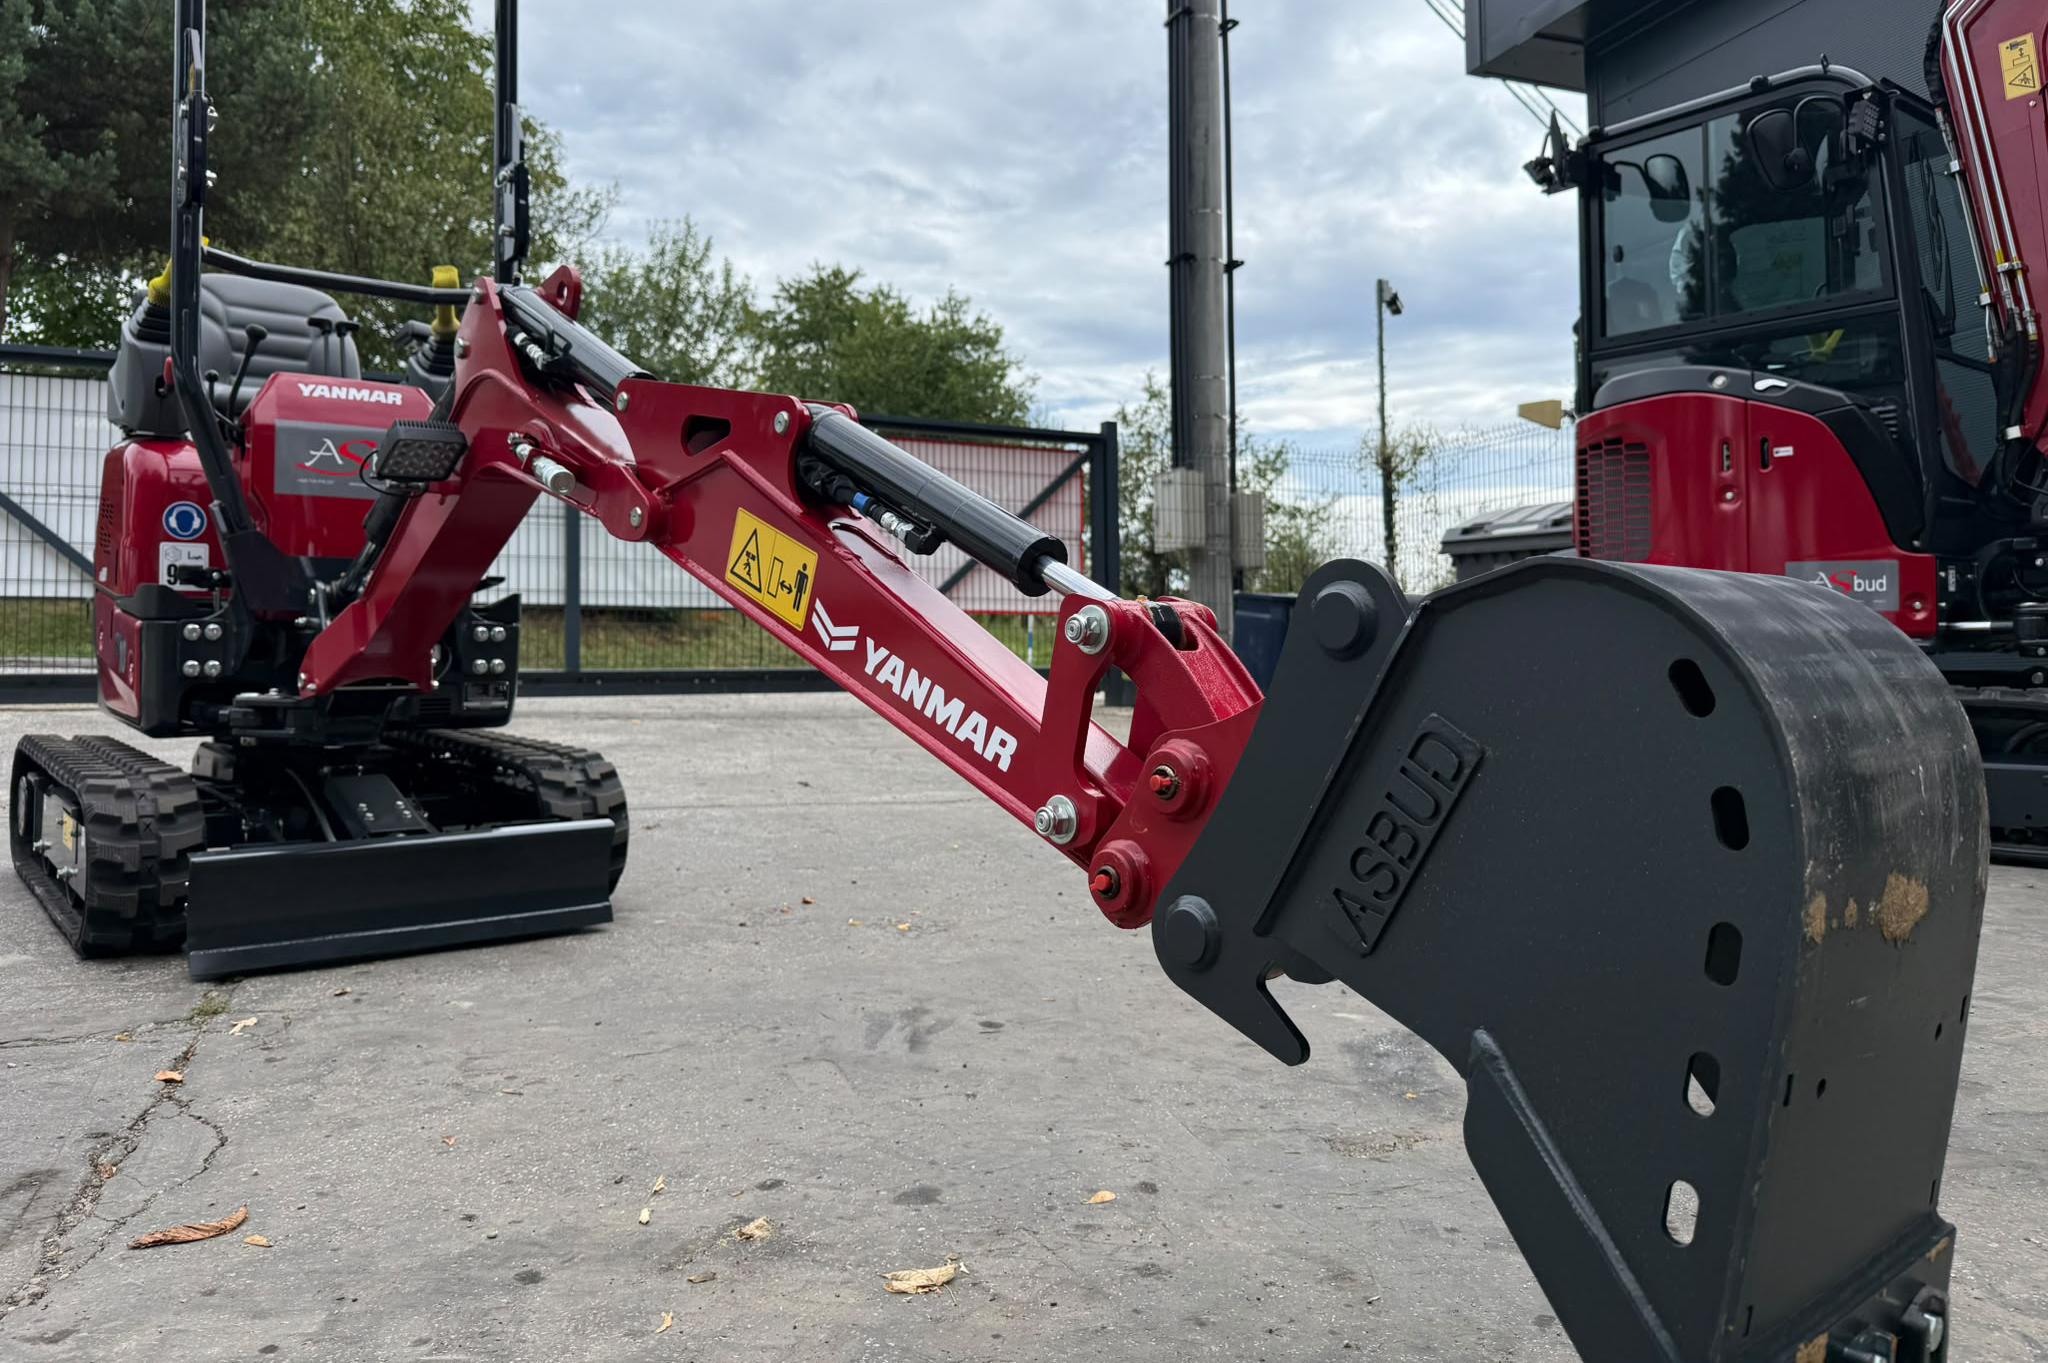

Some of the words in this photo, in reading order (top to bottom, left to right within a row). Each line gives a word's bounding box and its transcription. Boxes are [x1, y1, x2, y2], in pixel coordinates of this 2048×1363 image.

[297, 383, 402, 405] YANMAR
[1809, 570, 1887, 594] ASbud
[864, 636, 1018, 772] YANMAR
[1332, 731, 1464, 949] ASBUD
